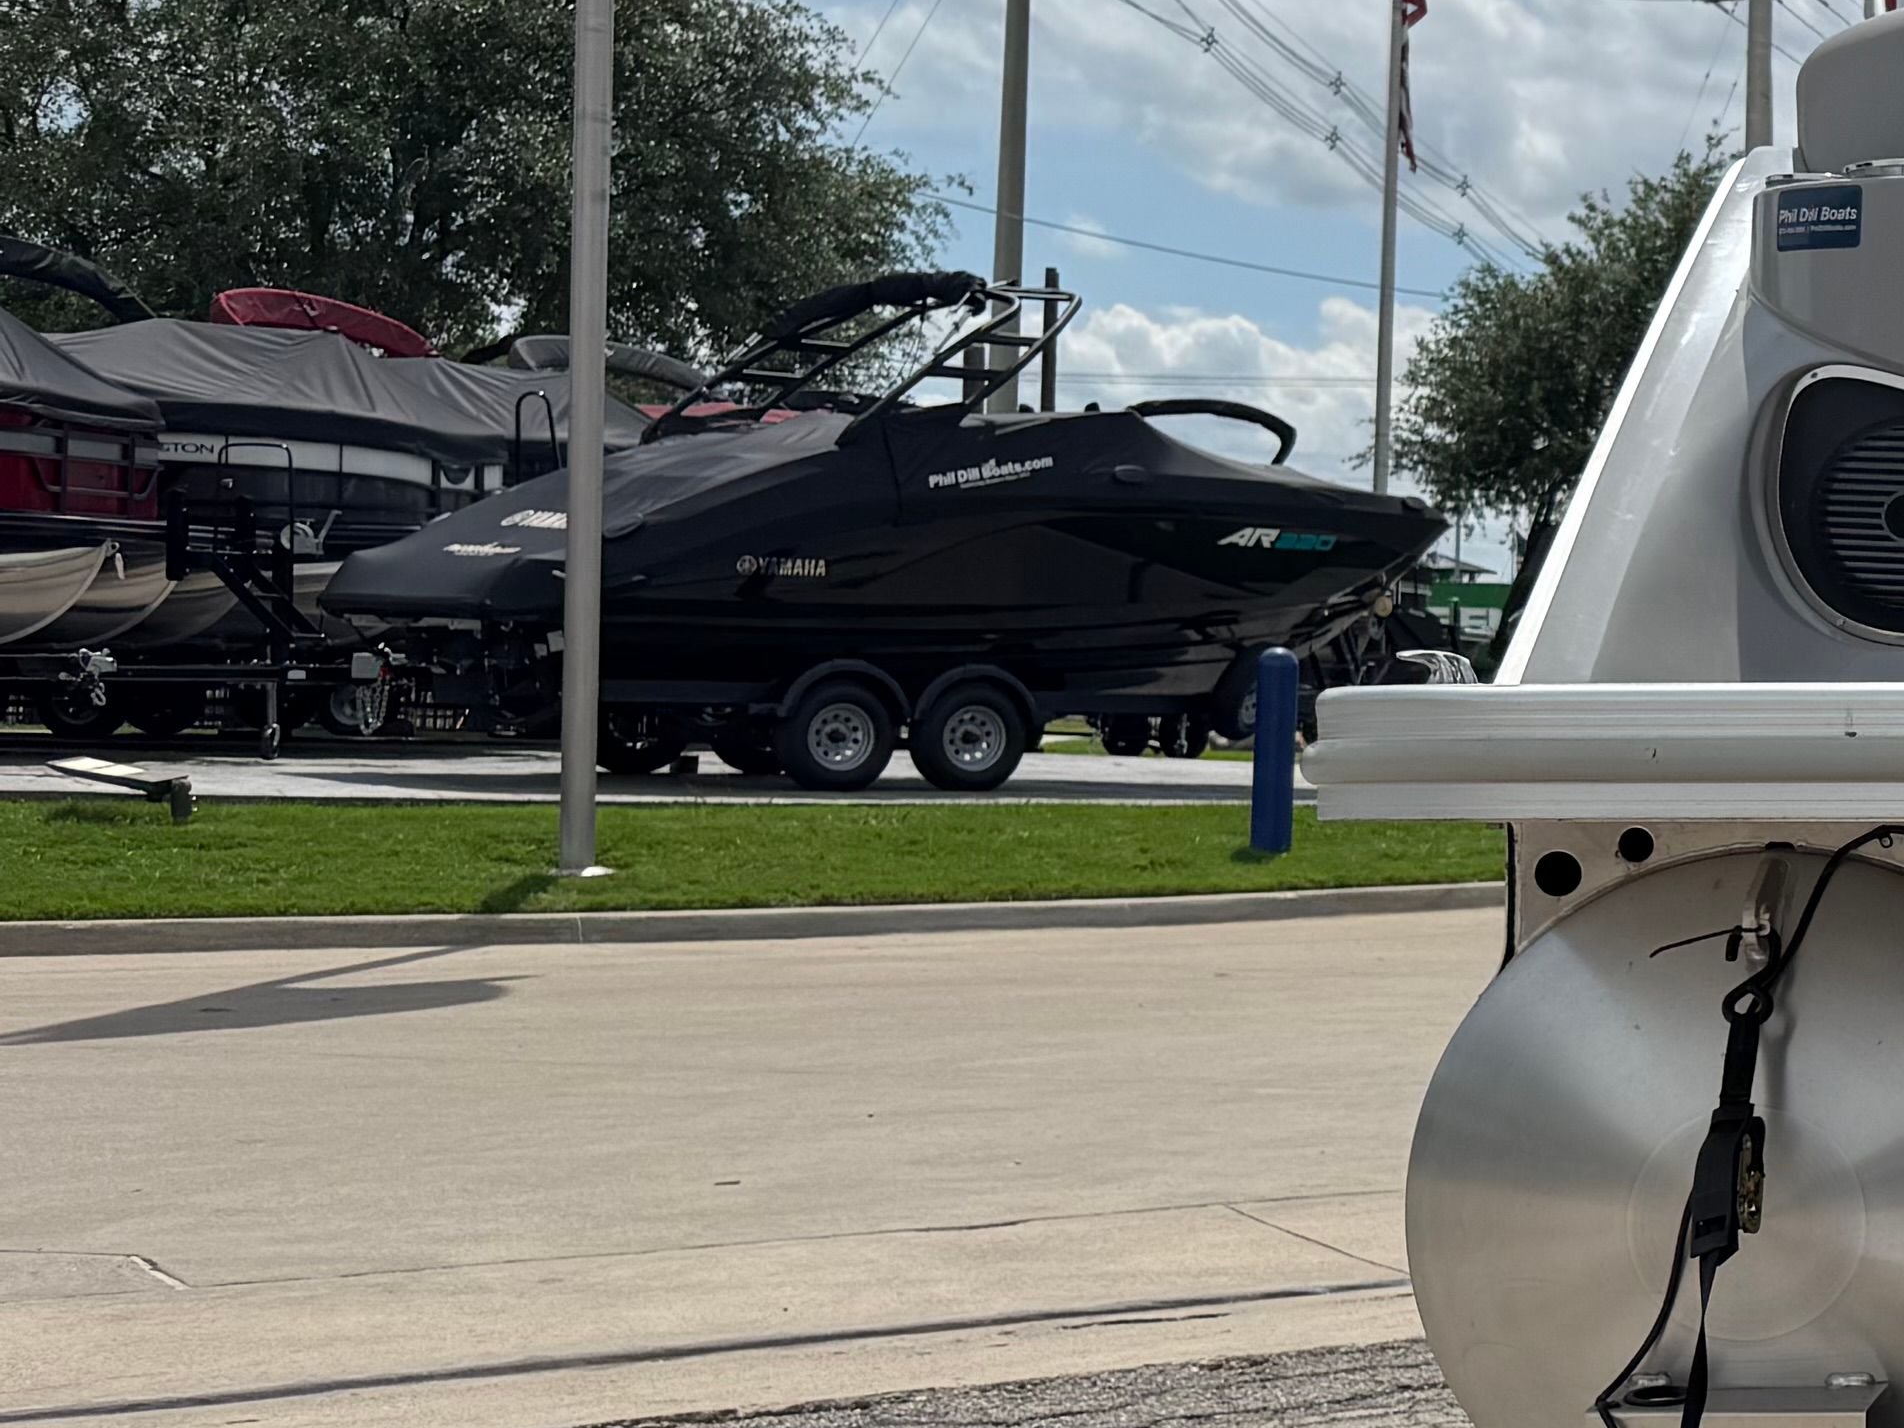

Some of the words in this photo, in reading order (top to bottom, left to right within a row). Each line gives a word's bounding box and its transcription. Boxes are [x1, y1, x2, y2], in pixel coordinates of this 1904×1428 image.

[1821, 206, 1857, 220] Boats
[928, 472, 956, 489] Phil
[957, 467, 980, 484] Dill
[758, 557, 826, 577] YAMAHA
